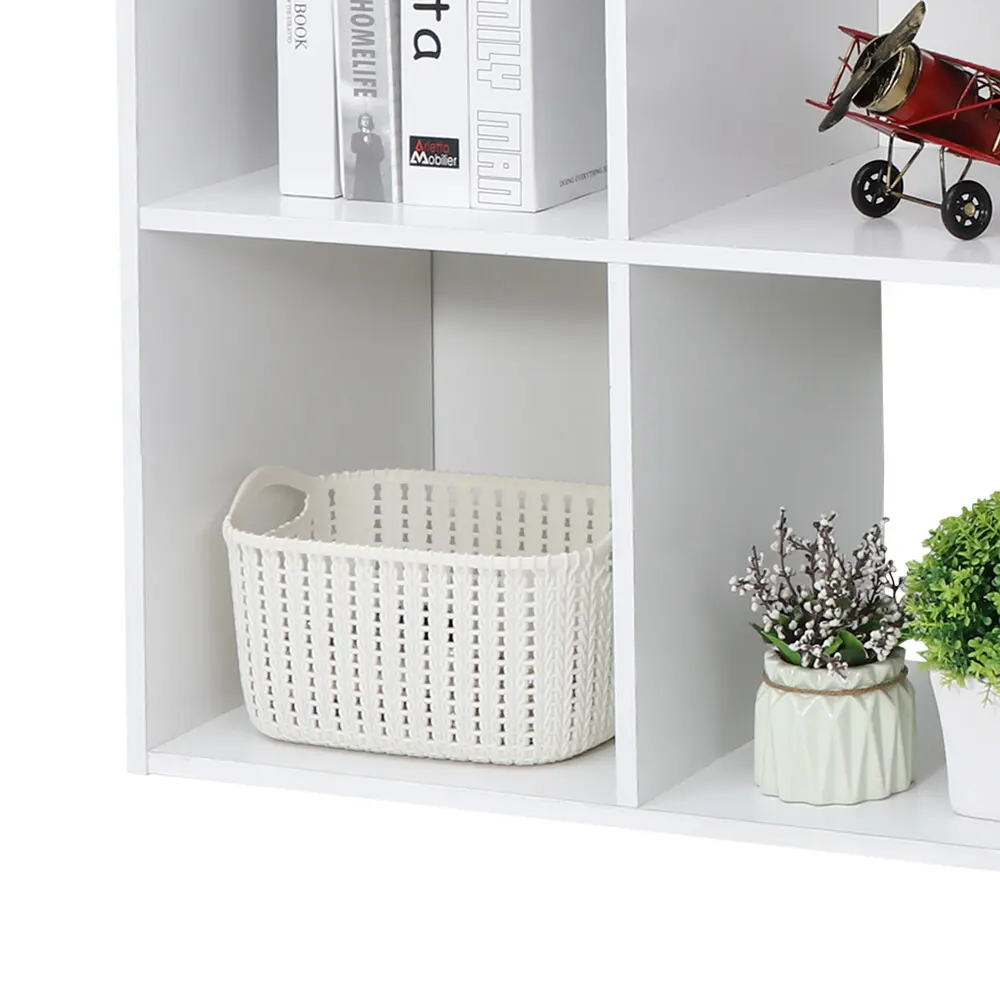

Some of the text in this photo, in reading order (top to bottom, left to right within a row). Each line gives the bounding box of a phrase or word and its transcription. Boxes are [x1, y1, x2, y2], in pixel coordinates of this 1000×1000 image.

[294, 3, 308, 50] BOOK
[350, 0, 377, 98] HOMELIFE
[477, 110, 523, 206] MAN
